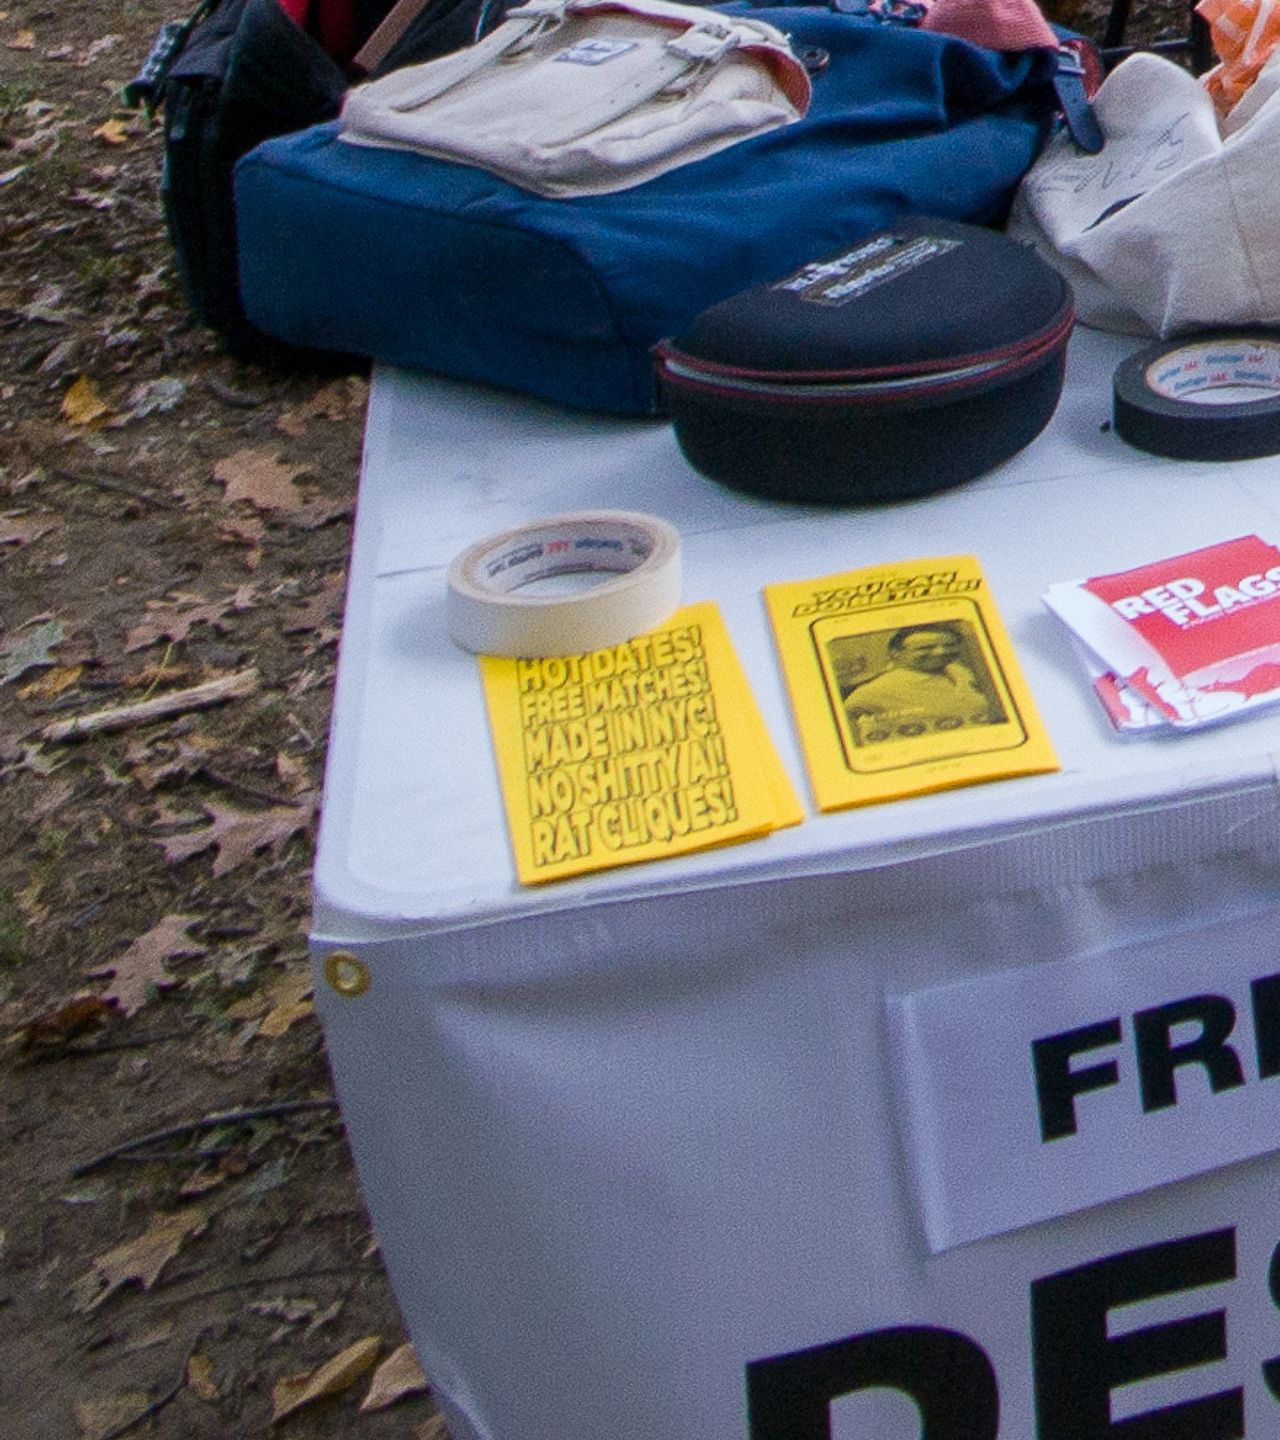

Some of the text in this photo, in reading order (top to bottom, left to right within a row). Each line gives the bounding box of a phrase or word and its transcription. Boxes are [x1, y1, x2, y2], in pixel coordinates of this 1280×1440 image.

[812, 571, 958, 607] YOU CAN
[1111, 577, 1205, 619] RED
[517, 624, 705, 692] HOT DATES!
[519, 661, 712, 728] FREE MATCHES!
[523, 694, 720, 774] MADE IN NYC!
[528, 737, 730, 818] NO SHITTY AI!
[531, 778, 739, 867] RAT CLIQUES!
